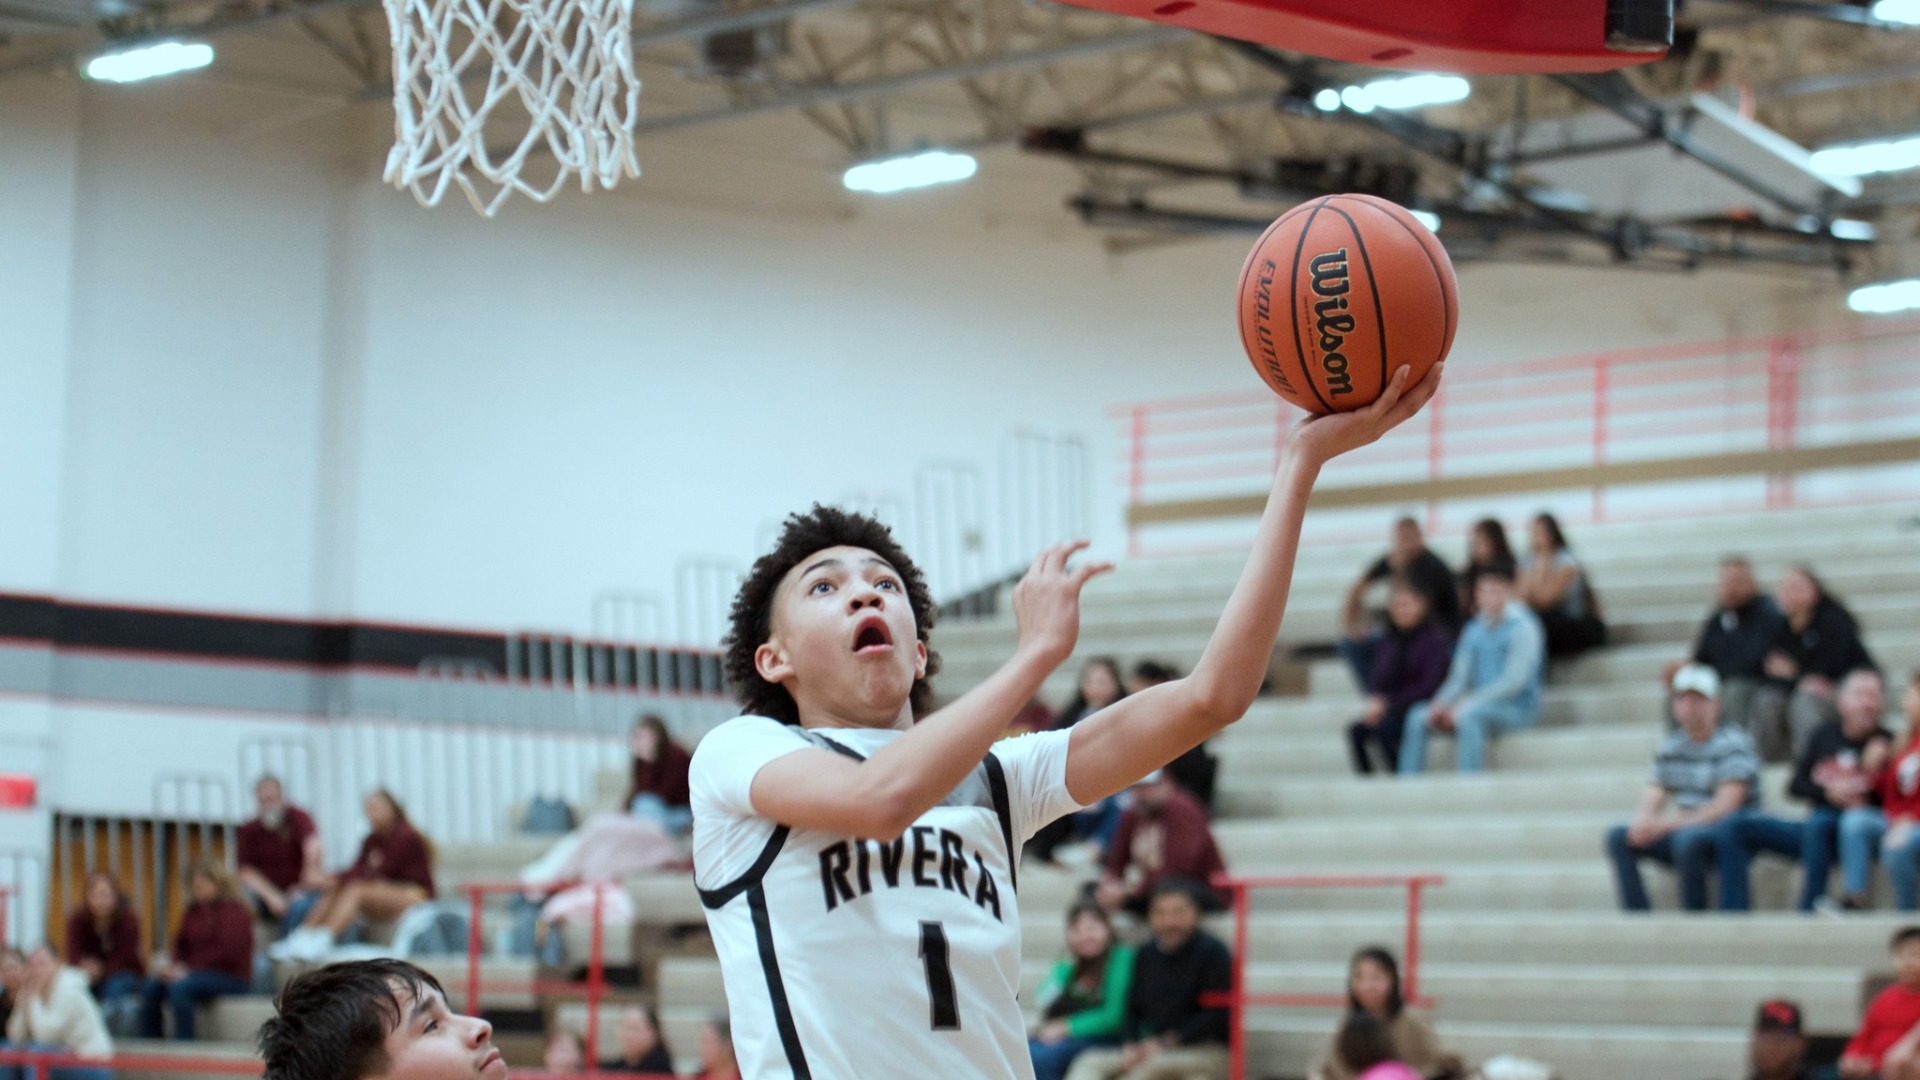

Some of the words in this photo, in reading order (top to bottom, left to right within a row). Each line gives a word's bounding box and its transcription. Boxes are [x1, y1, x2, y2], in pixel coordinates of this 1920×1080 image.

[1257, 259, 1298, 395] EVOLUTION
[1309, 247, 1355, 397] Wilson
[818, 826, 1004, 924] RIVERA
[917, 920, 961, 1031] 1
